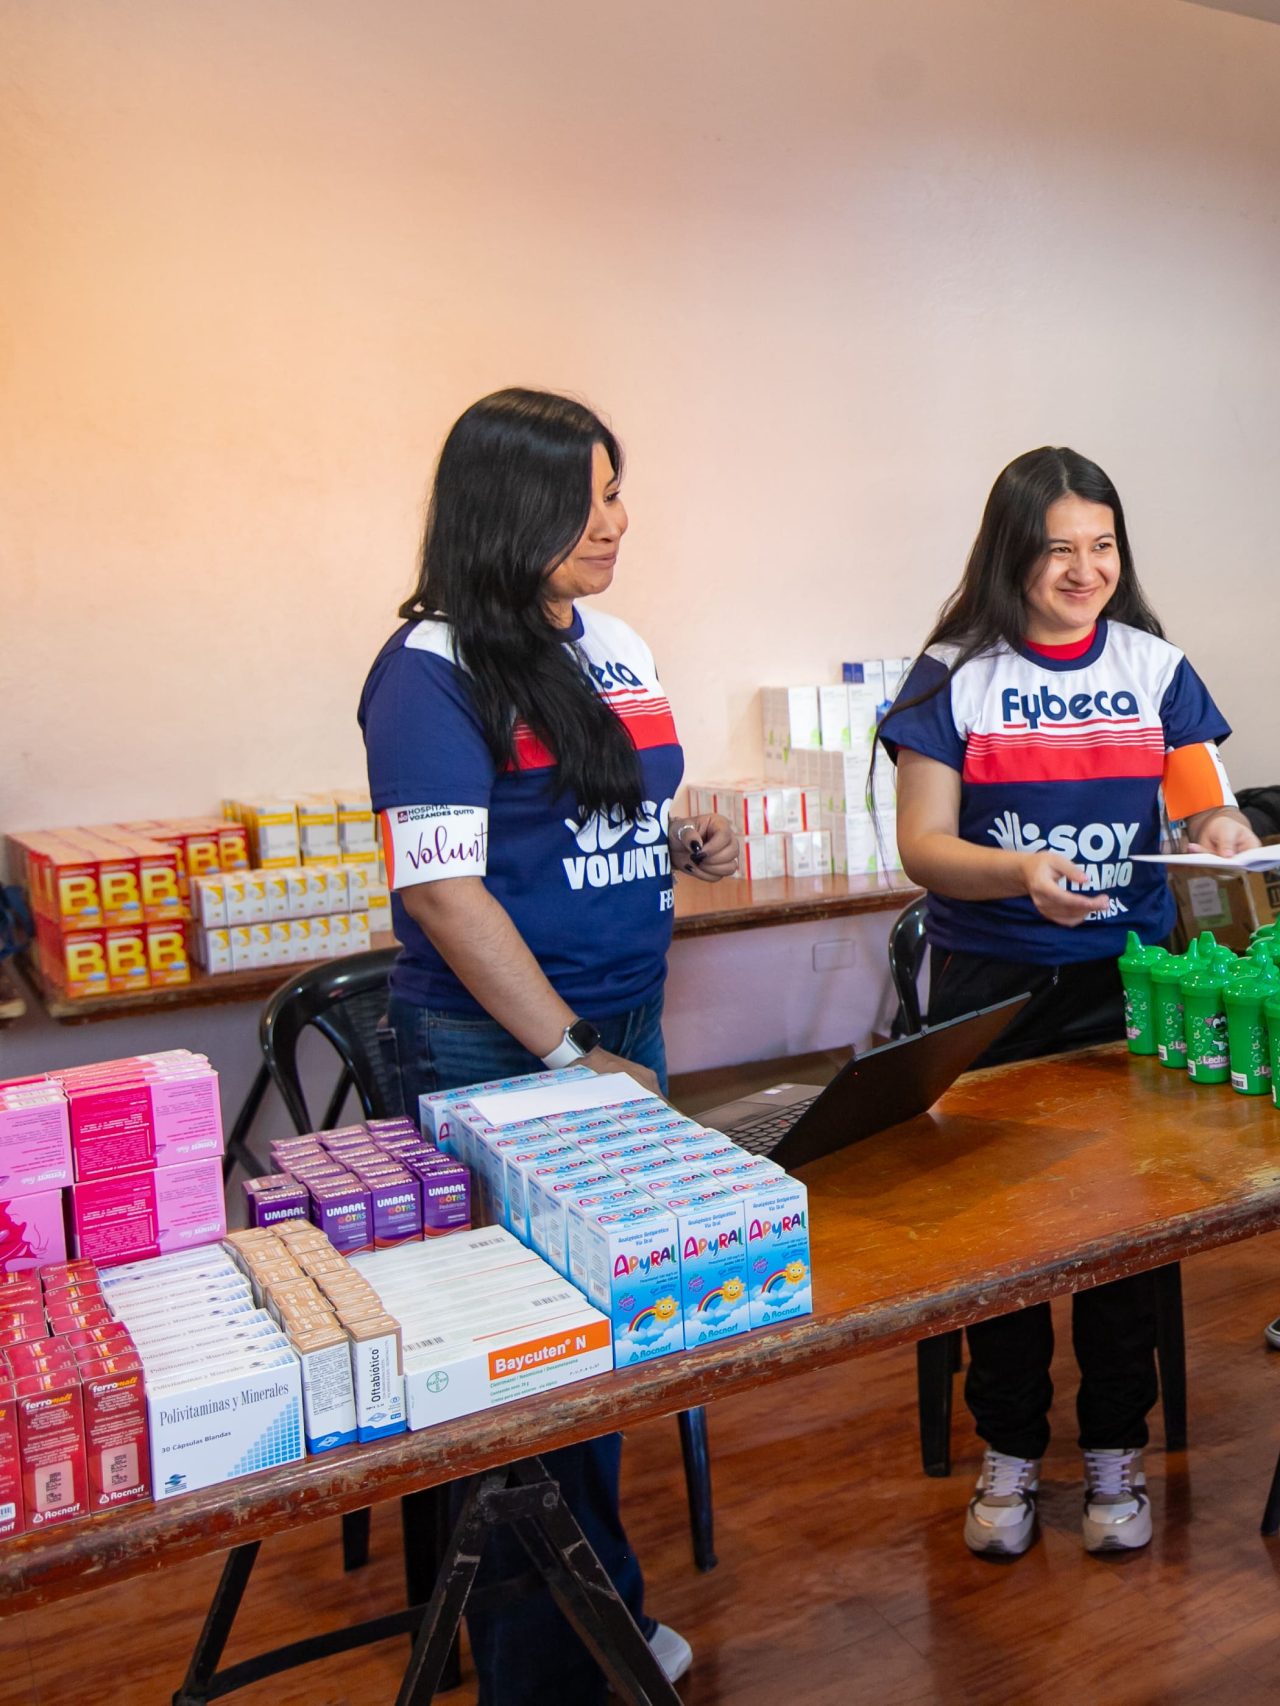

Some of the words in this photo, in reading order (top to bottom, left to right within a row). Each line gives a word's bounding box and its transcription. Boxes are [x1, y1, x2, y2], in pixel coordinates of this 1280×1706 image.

[408, 804, 451, 815] HOSPITAL
[410, 810, 451, 821] VOZANDES
[453, 808, 474, 816] QUITO
[406, 821, 488, 870] Volunt
[1048, 822, 1140, 862] SOY
[563, 844, 673, 890] VOLUNT
[1058, 862, 1133, 891] TARIO
[59, 875, 99, 916] B
[100, 871, 140, 911] B
[141, 867, 178, 906] B
[65, 941, 106, 982] B
[107, 937, 146, 977] B
[148, 931, 187, 972] B
[377, 1193, 416, 1208] UMBRAL
[428, 1183, 466, 1197] UMBRAL
[264, 1206, 306, 1221] UMBRAL
[326, 1202, 367, 1217] UMBRAL
[159, 1398, 231, 1427] Polivitaminas
[232, 1396, 239, 1412] y
[240, 1382, 289, 1406] Minerales
[172, 1438, 203, 1452] Cápsulas
[204, 1430, 232, 1442] Blandas
[111, 1485, 145, 1499] Rocnarf
[45, 1502, 81, 1519] Rocnarf
